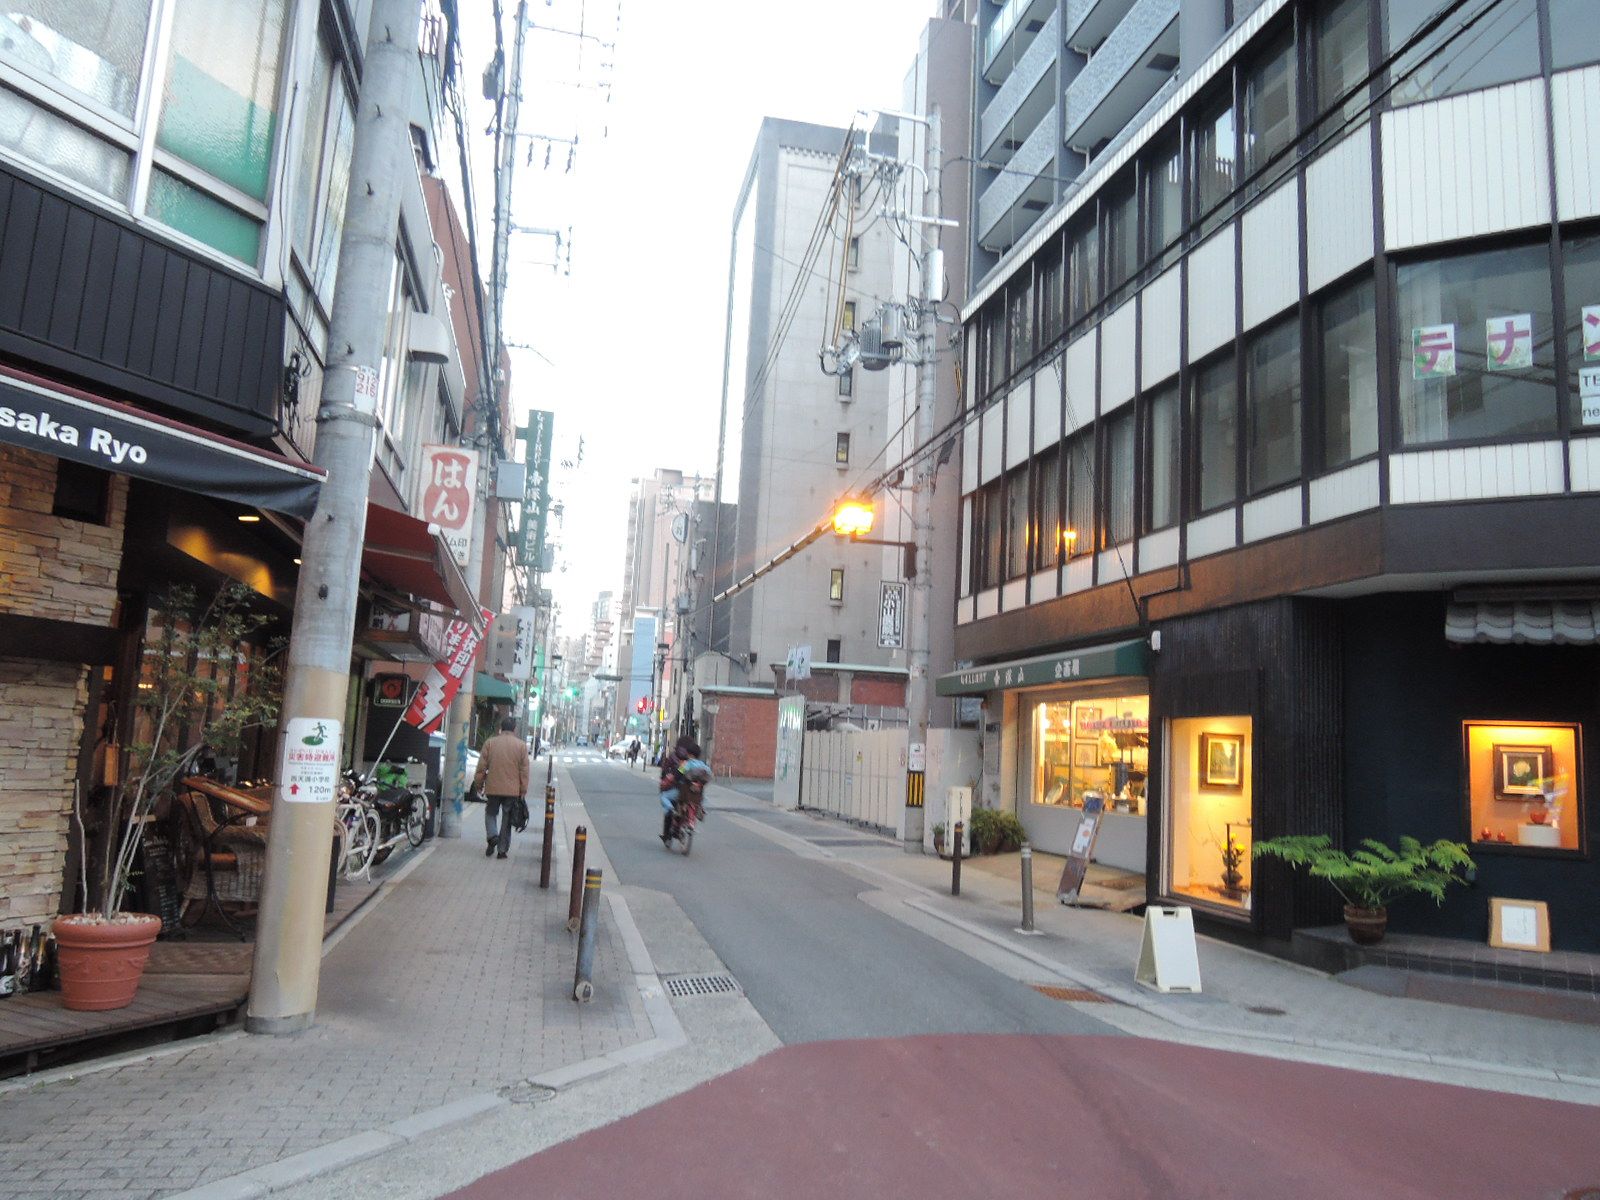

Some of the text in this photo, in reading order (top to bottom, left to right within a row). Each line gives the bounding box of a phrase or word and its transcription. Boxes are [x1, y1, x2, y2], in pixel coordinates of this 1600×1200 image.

[89, 427, 148, 465] Ryo
[432, 458, 463, 522] はん
[446, 536, 468, 548] ム印
[309, 786, 331, 794] 120m
